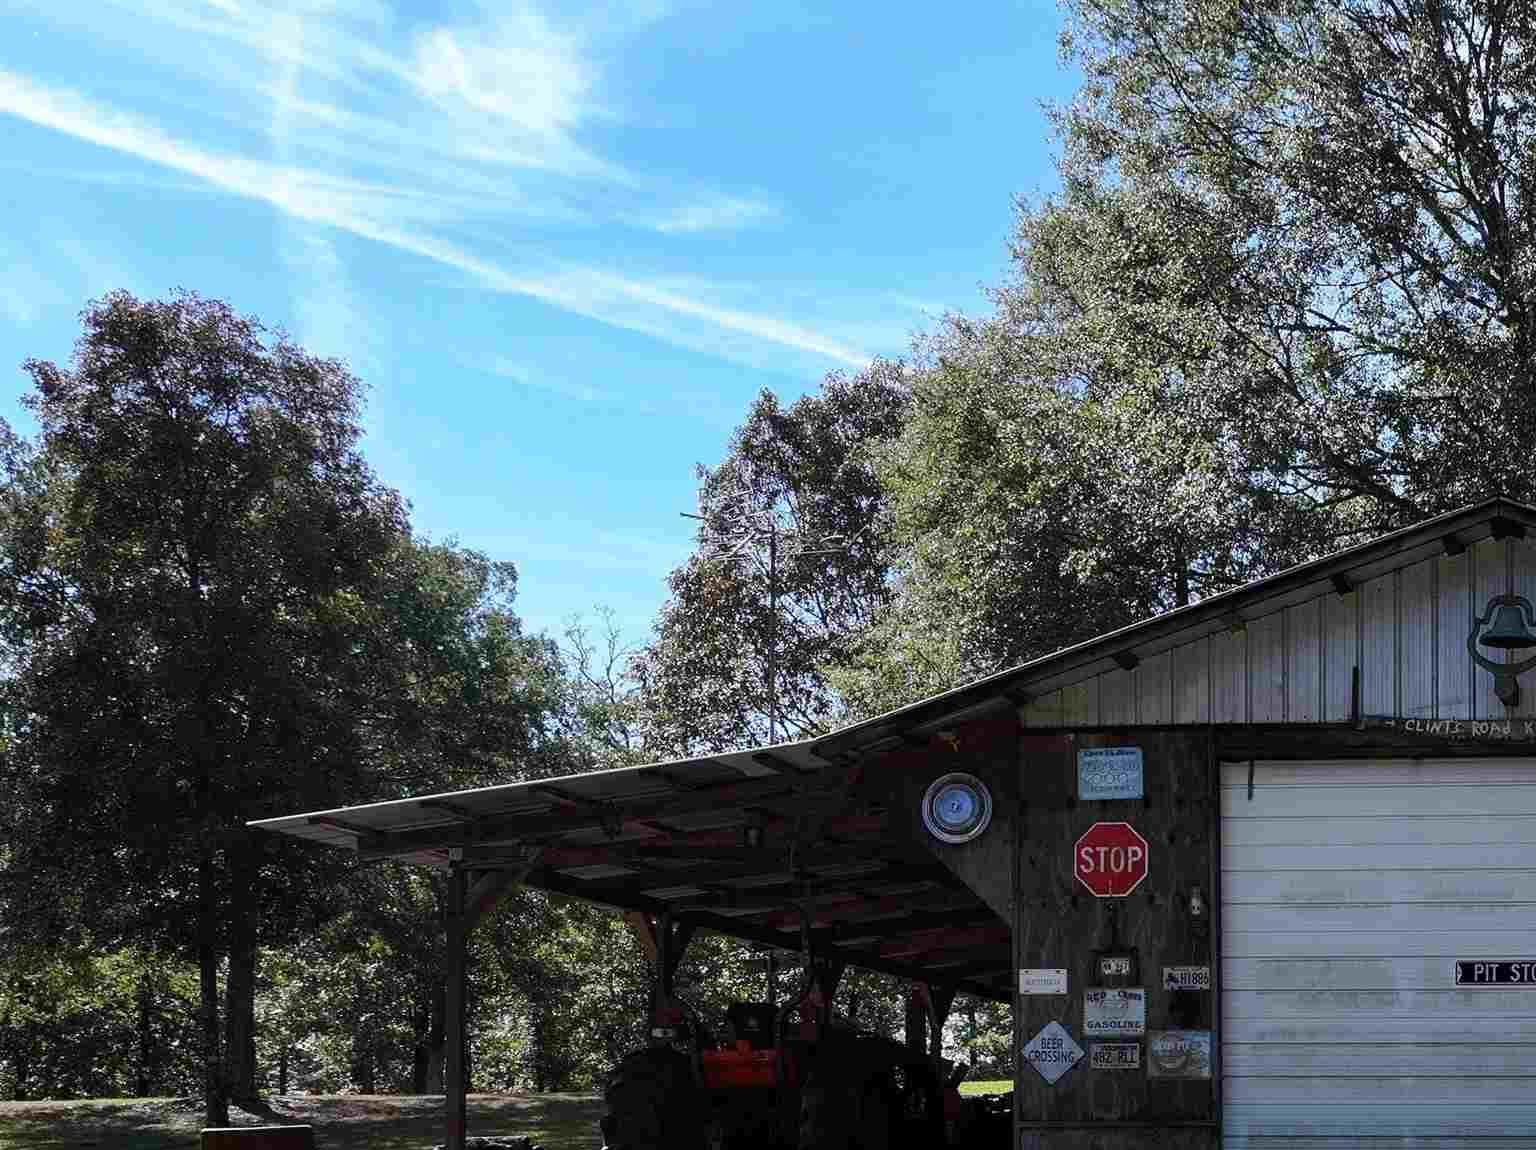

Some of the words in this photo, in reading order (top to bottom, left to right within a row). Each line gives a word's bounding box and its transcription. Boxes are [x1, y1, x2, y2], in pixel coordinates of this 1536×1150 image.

[1080, 847, 1142, 873] STOP
[1474, 963, 1500, 982] PIT
[1087, 1020, 1142, 1030] GASOLINE
[1028, 1049, 1073, 1064] CROSSING
